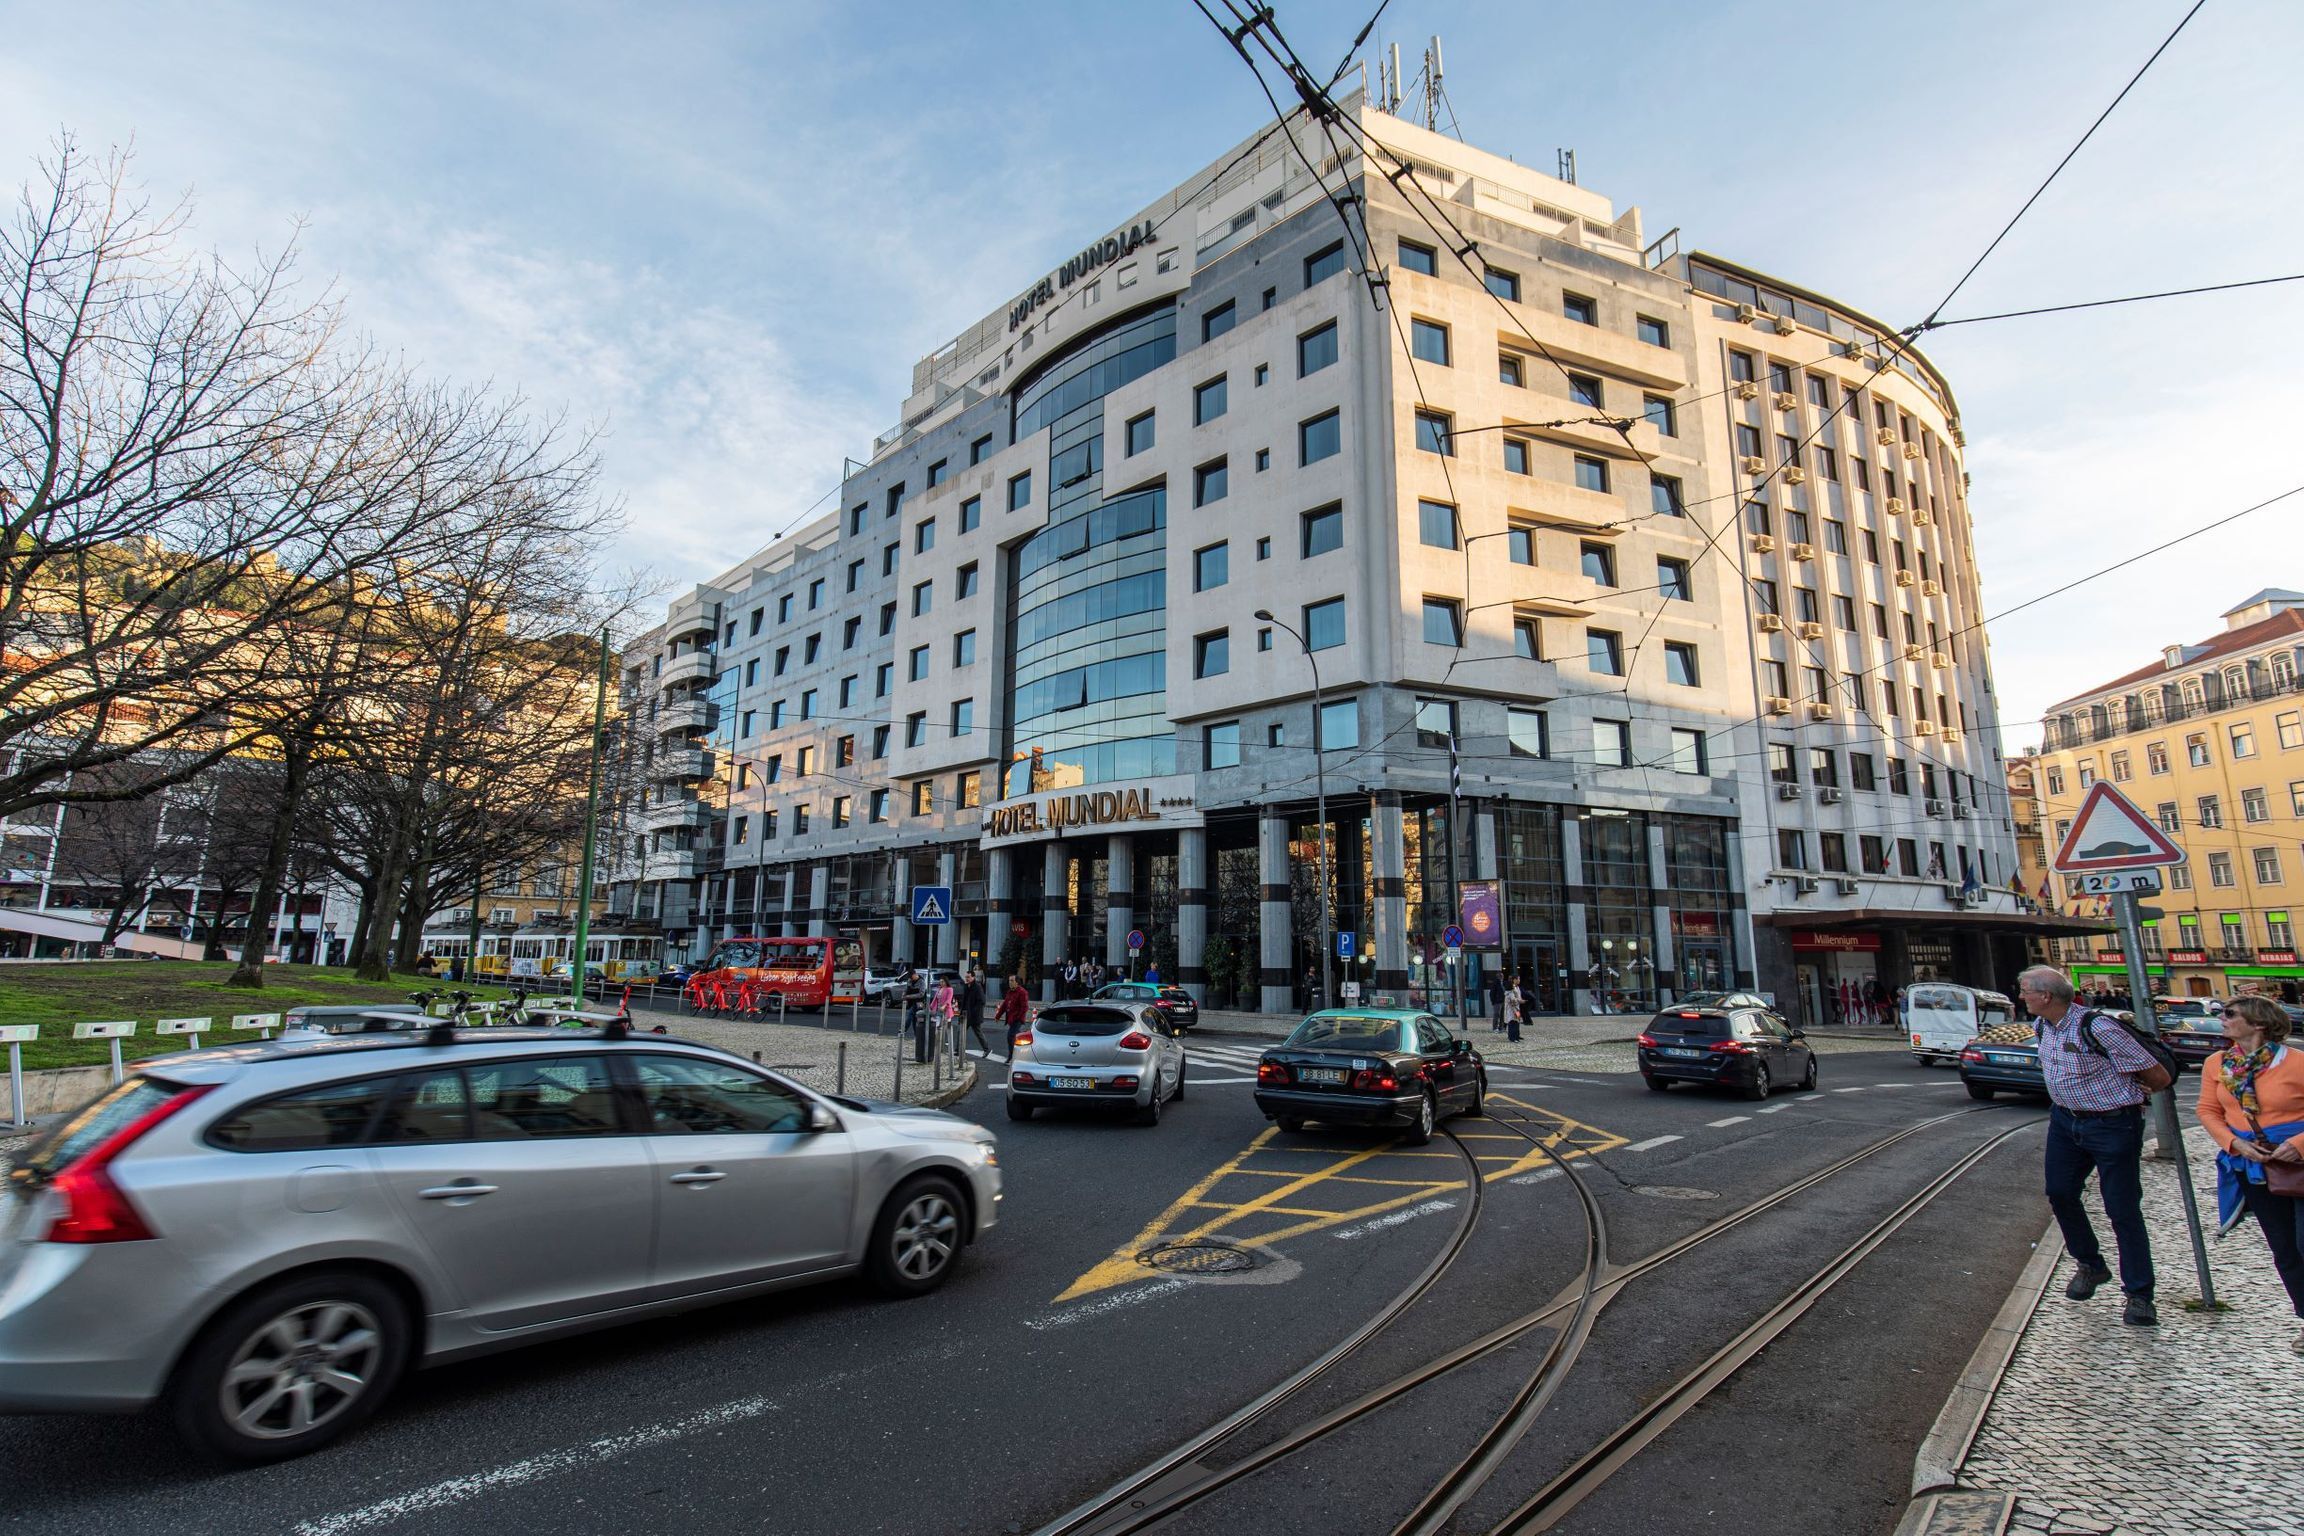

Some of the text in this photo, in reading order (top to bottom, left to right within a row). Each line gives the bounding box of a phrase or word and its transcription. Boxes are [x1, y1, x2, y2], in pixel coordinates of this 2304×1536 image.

[1008, 219, 1157, 333] HOTEL MUNDIAL
[990, 787, 1160, 837] HOTEL MUNDIAL
[1341, 934, 1349, 950] P
[1814, 932, 1859, 946] Millennium
[2172, 953, 2202, 962] SALDOS
[760, 971, 779, 982] Lisbon
[781, 971, 817, 985] Sightseeing
